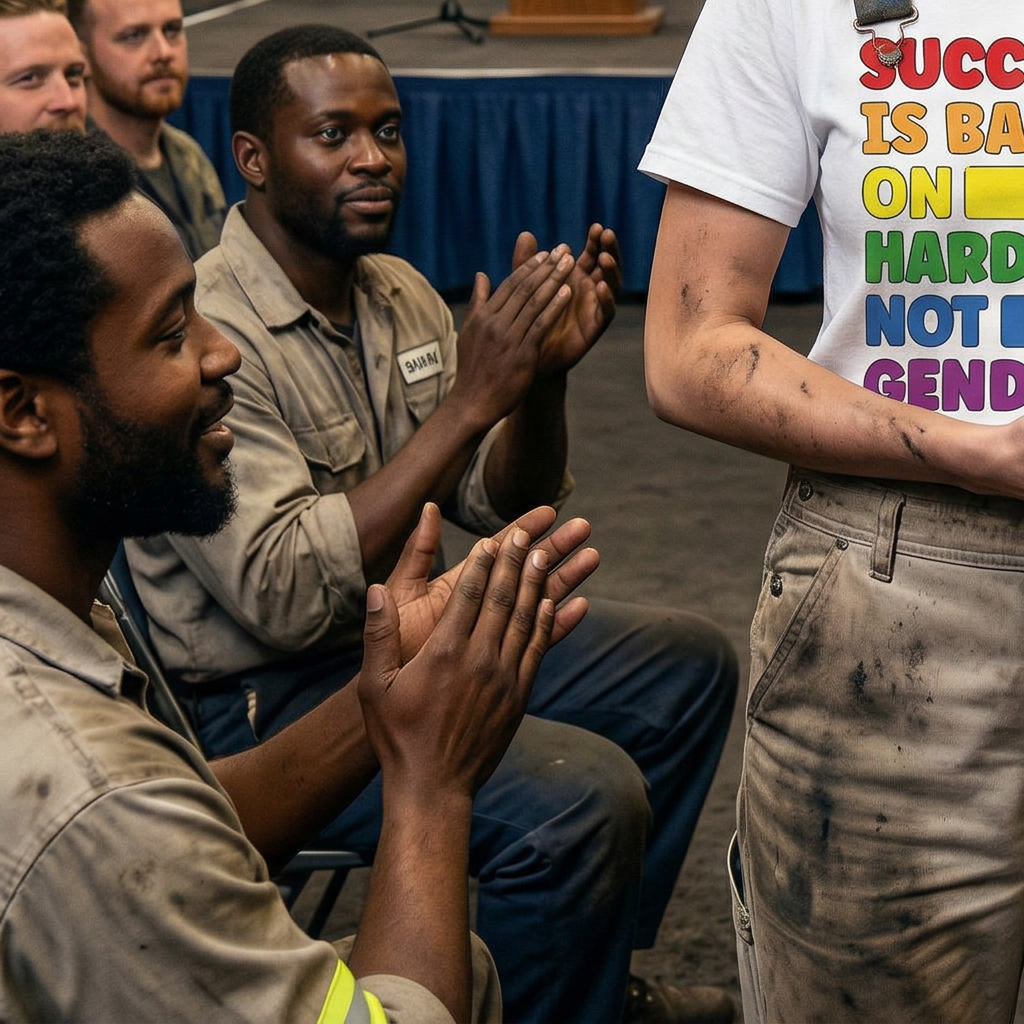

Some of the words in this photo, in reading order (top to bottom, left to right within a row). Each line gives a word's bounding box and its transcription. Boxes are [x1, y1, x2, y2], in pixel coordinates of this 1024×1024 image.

[860, 101, 928, 155] IS
[861, 165, 952, 220] ON
[865, 294, 989, 348] NOT
